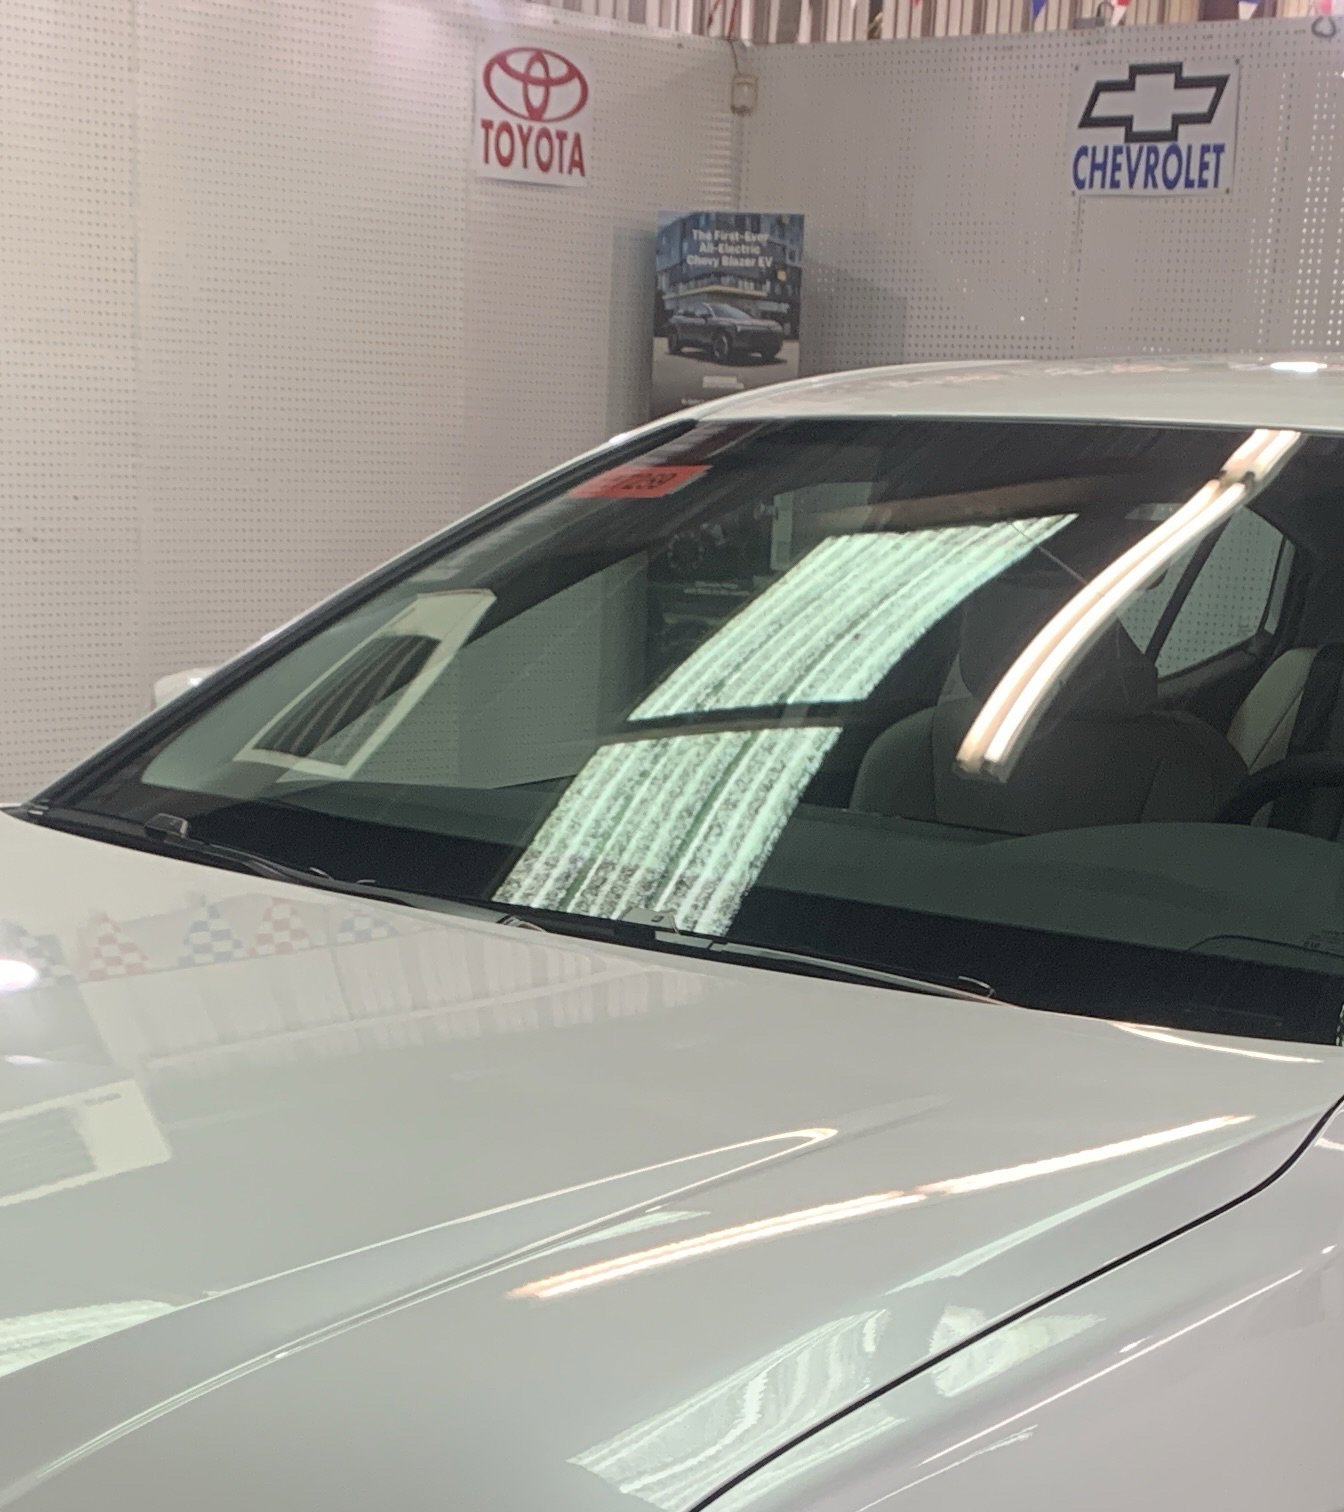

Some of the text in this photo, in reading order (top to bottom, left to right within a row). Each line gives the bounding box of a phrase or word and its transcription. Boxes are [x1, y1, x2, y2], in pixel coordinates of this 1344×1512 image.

[480, 118, 586, 177] TOYOTA
[1072, 143, 1226, 190] CHEVROLET
[692, 229, 770, 243] The First-Ever
[687, 256, 773, 268] Chevy Blazer EV
